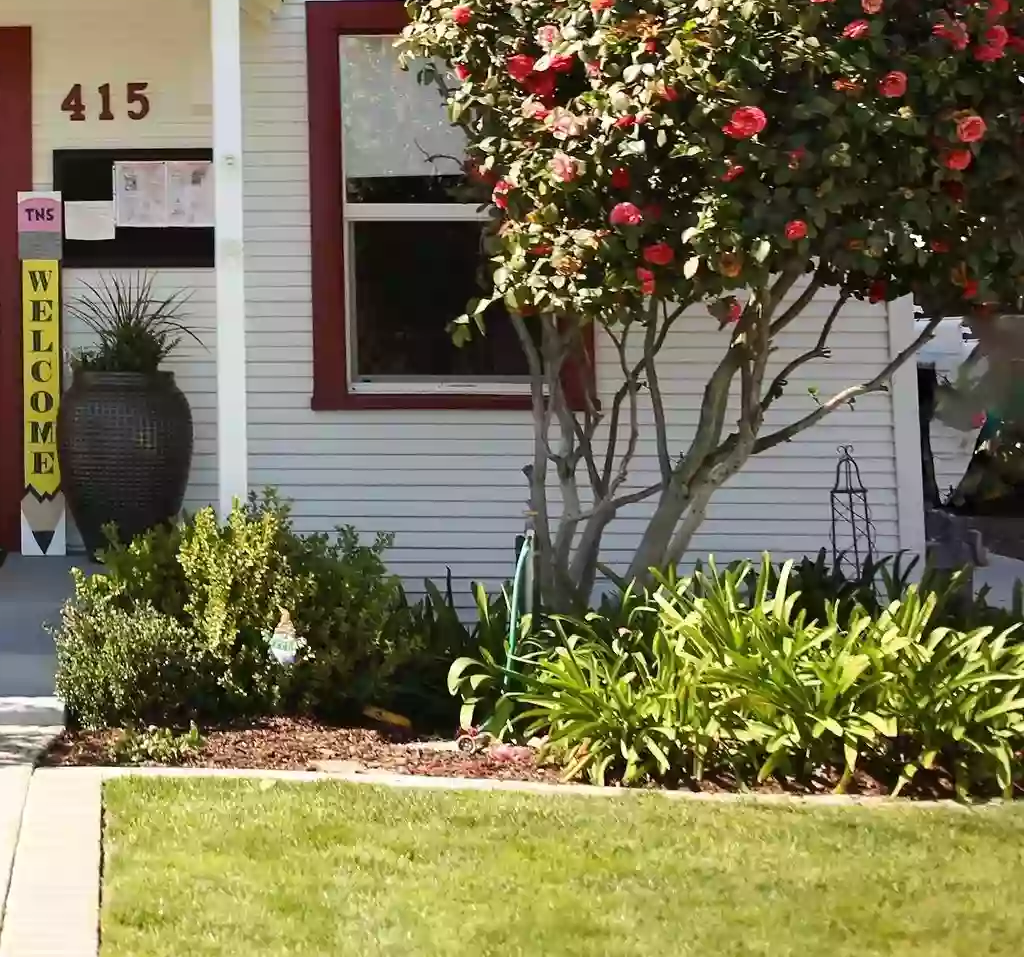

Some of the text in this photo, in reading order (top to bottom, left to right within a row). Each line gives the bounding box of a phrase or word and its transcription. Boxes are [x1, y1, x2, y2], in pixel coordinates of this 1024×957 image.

[61, 83, 150, 120] 415
[25, 208, 55, 222] TNS
[28, 270, 57, 474] WELCOME
